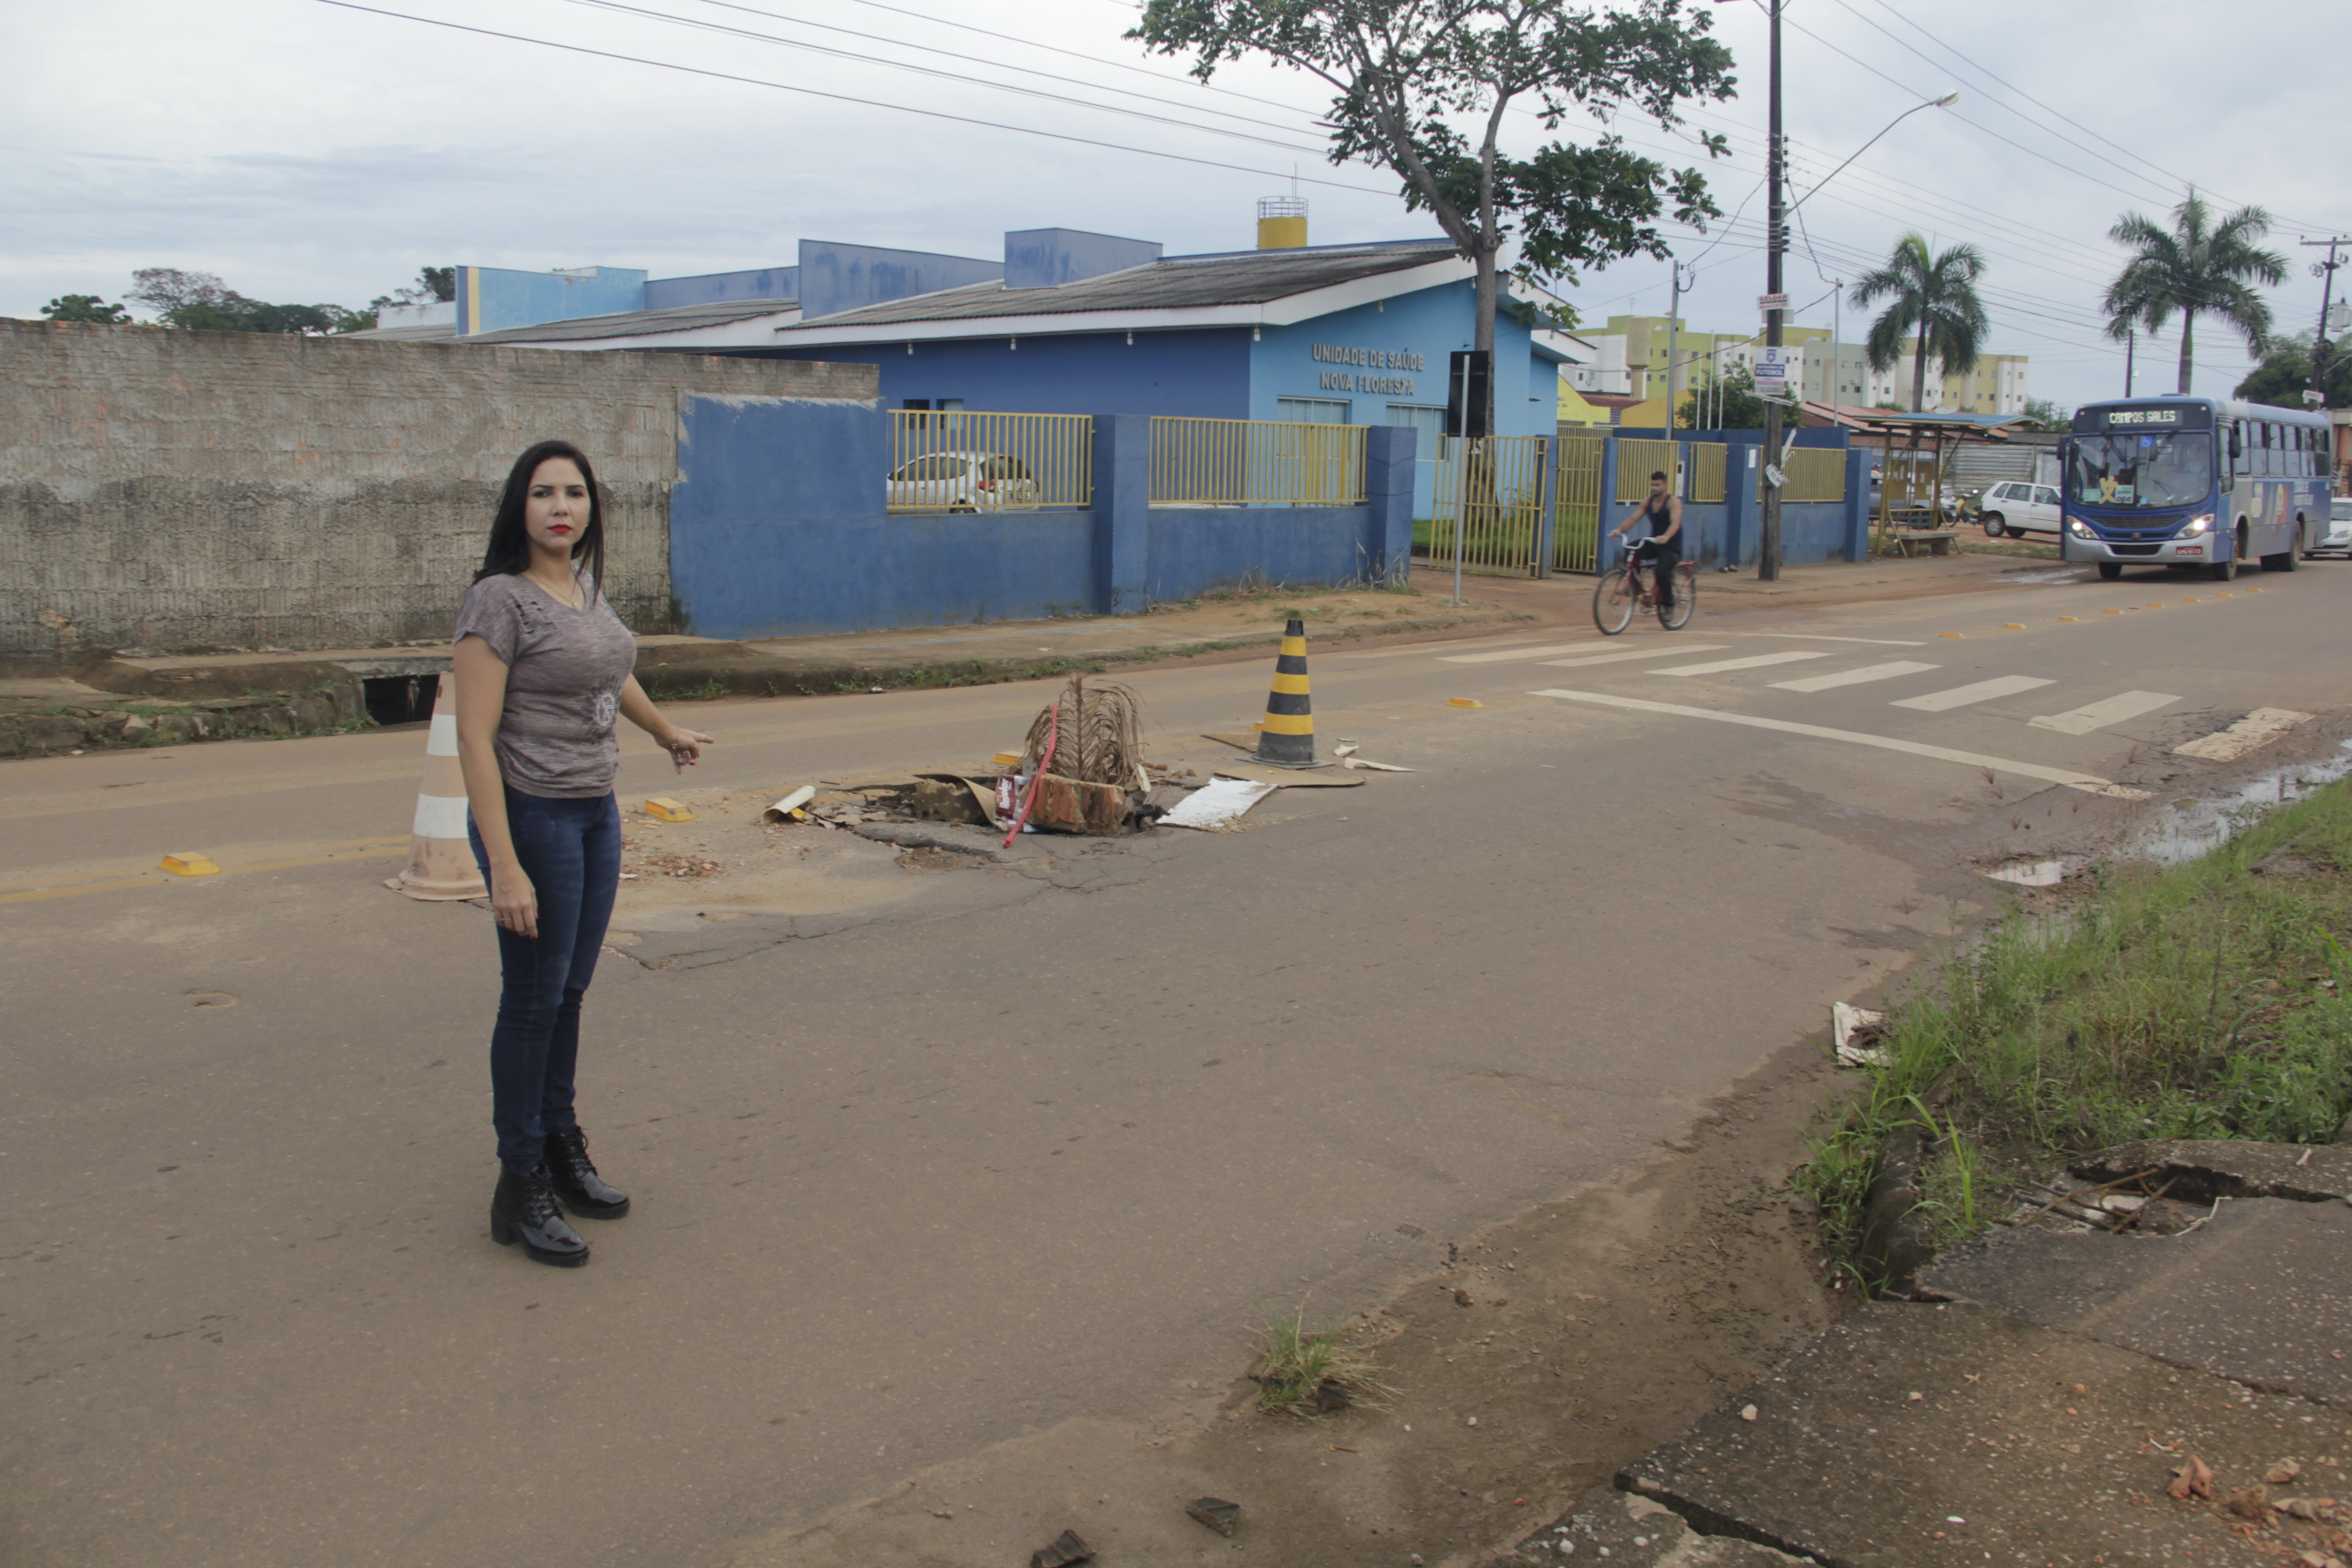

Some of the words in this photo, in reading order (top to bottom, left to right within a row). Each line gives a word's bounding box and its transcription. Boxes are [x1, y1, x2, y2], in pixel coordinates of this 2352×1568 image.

[1312, 344, 1367, 366] UNIDADE
[1368, 349, 1385, 368] DE
[1387, 347, 1425, 371] SAÚDE
[1320, 372, 1353, 391] NOVA
[1357, 375, 1415, 396] FLORESTA
[2109, 411, 2144, 424] CAMPOS
[2146, 410, 2176, 422] SALES
